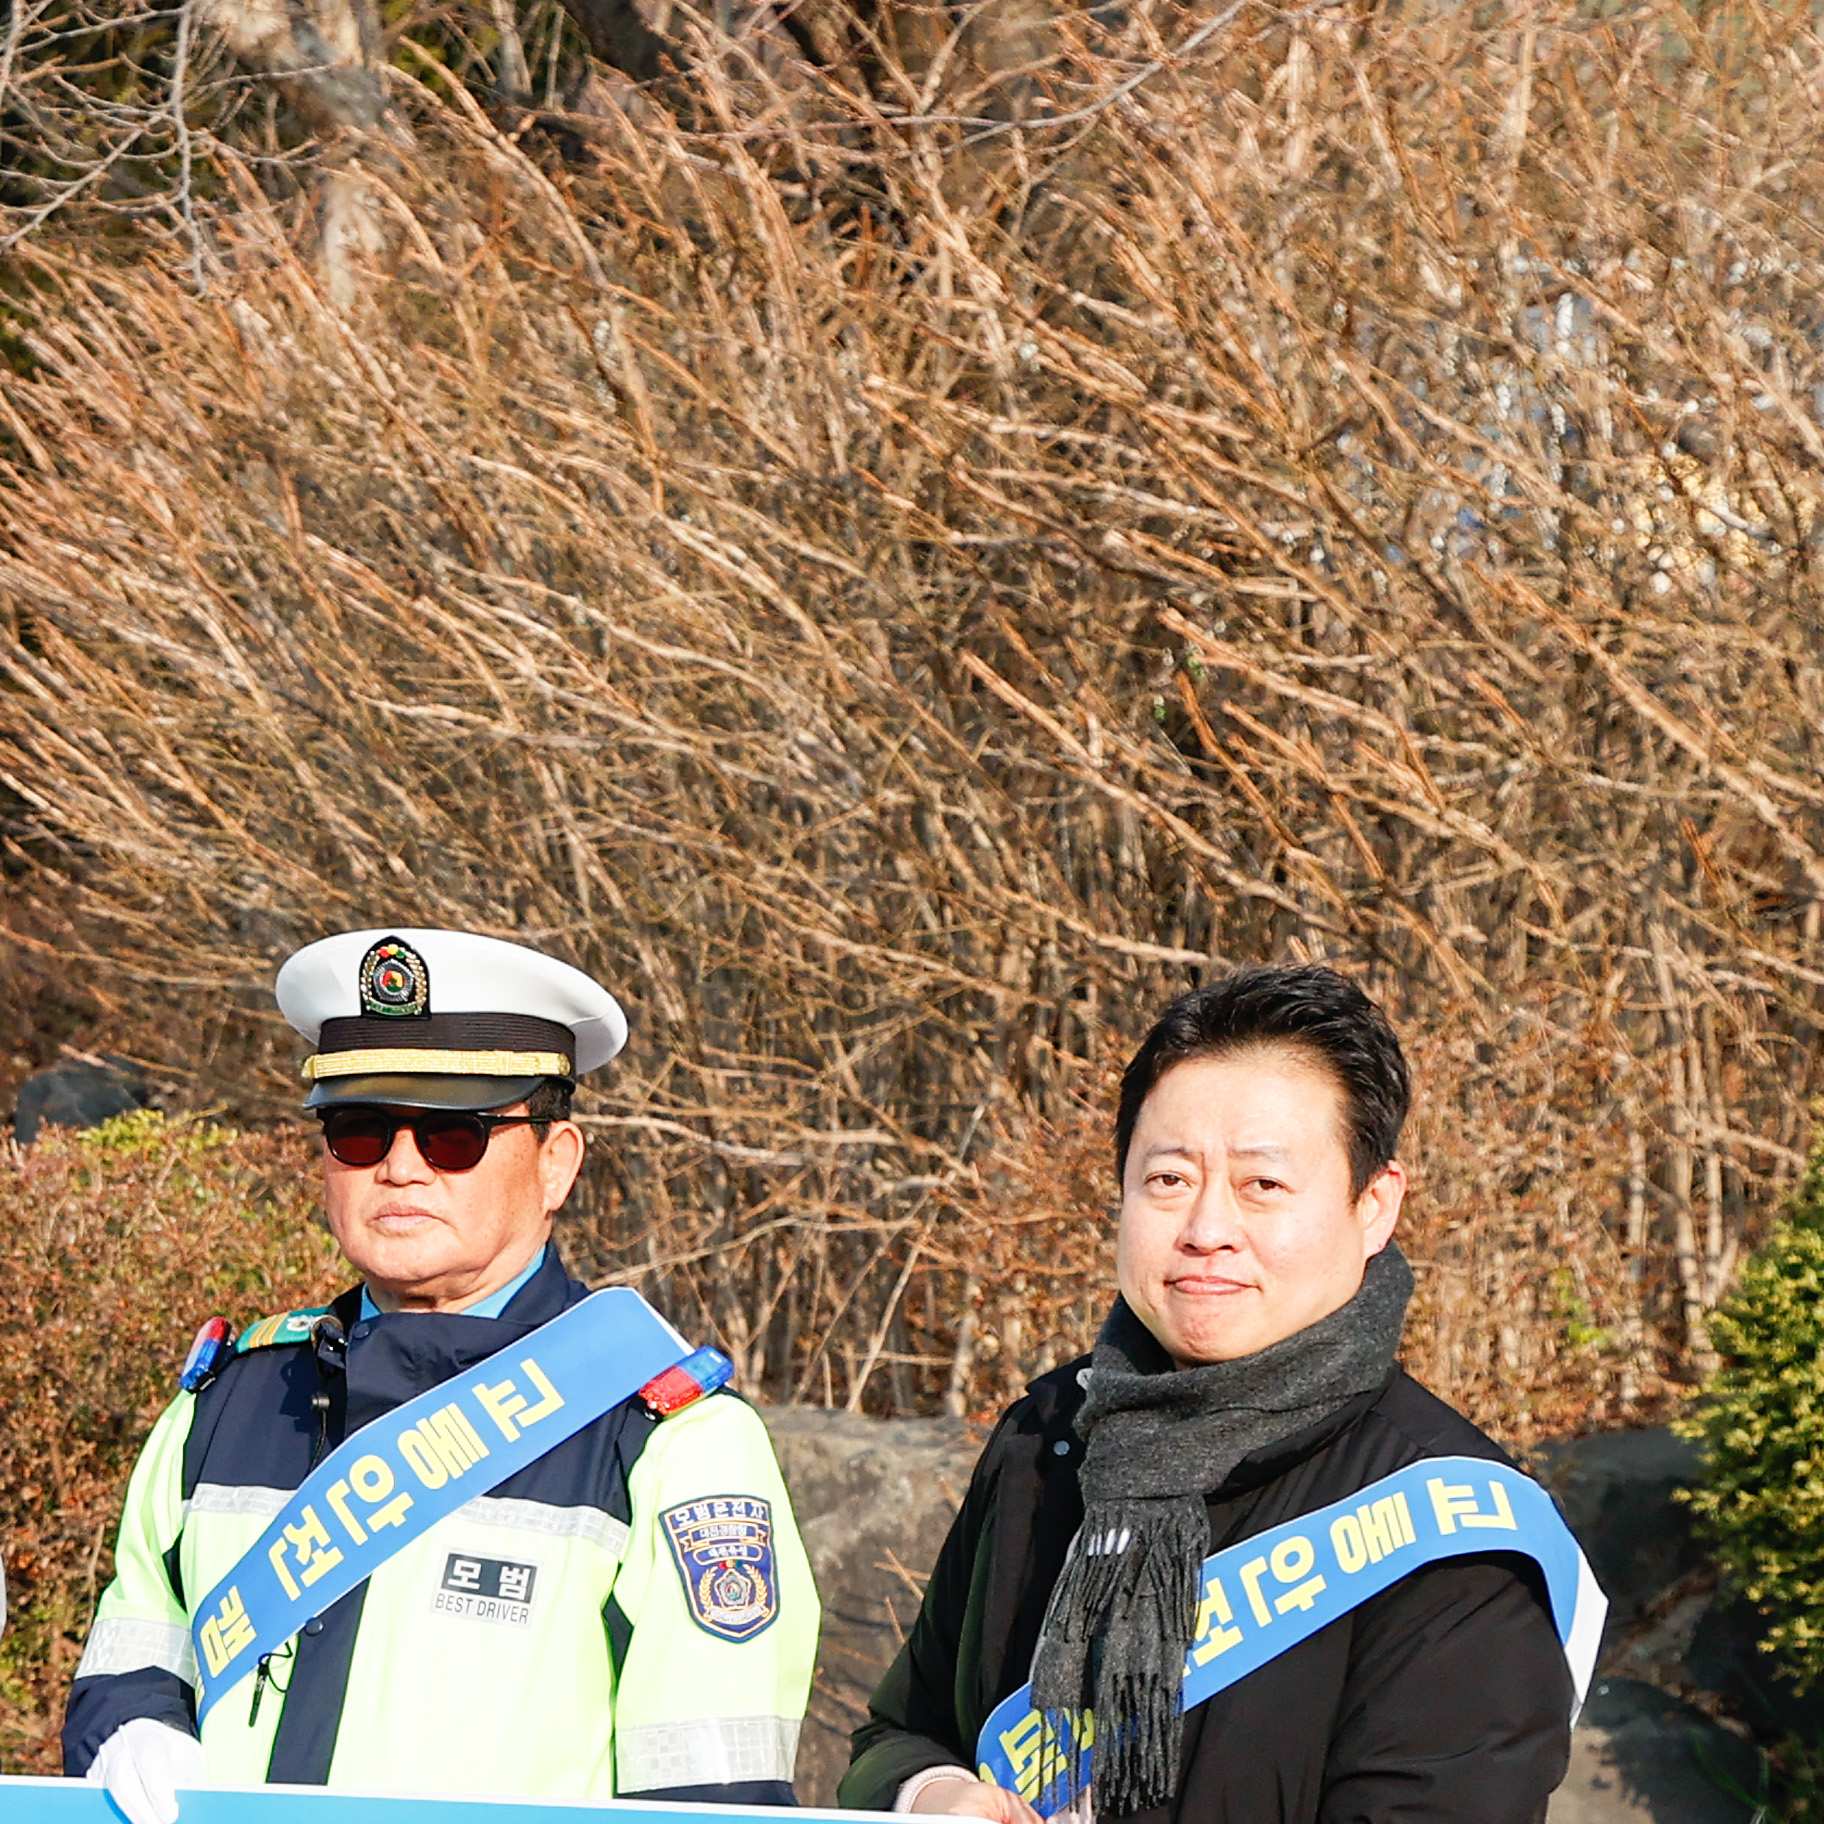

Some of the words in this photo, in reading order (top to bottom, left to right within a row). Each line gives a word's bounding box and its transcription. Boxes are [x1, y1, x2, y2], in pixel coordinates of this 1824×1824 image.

[272, 1362, 561, 1598] 교통안전
[674, 1501, 765, 1527] 모범운전자
[448, 1559, 530, 1600] 모범
[435, 1593, 473, 1614] BEST
[477, 1600, 529, 1624] DRIVER
